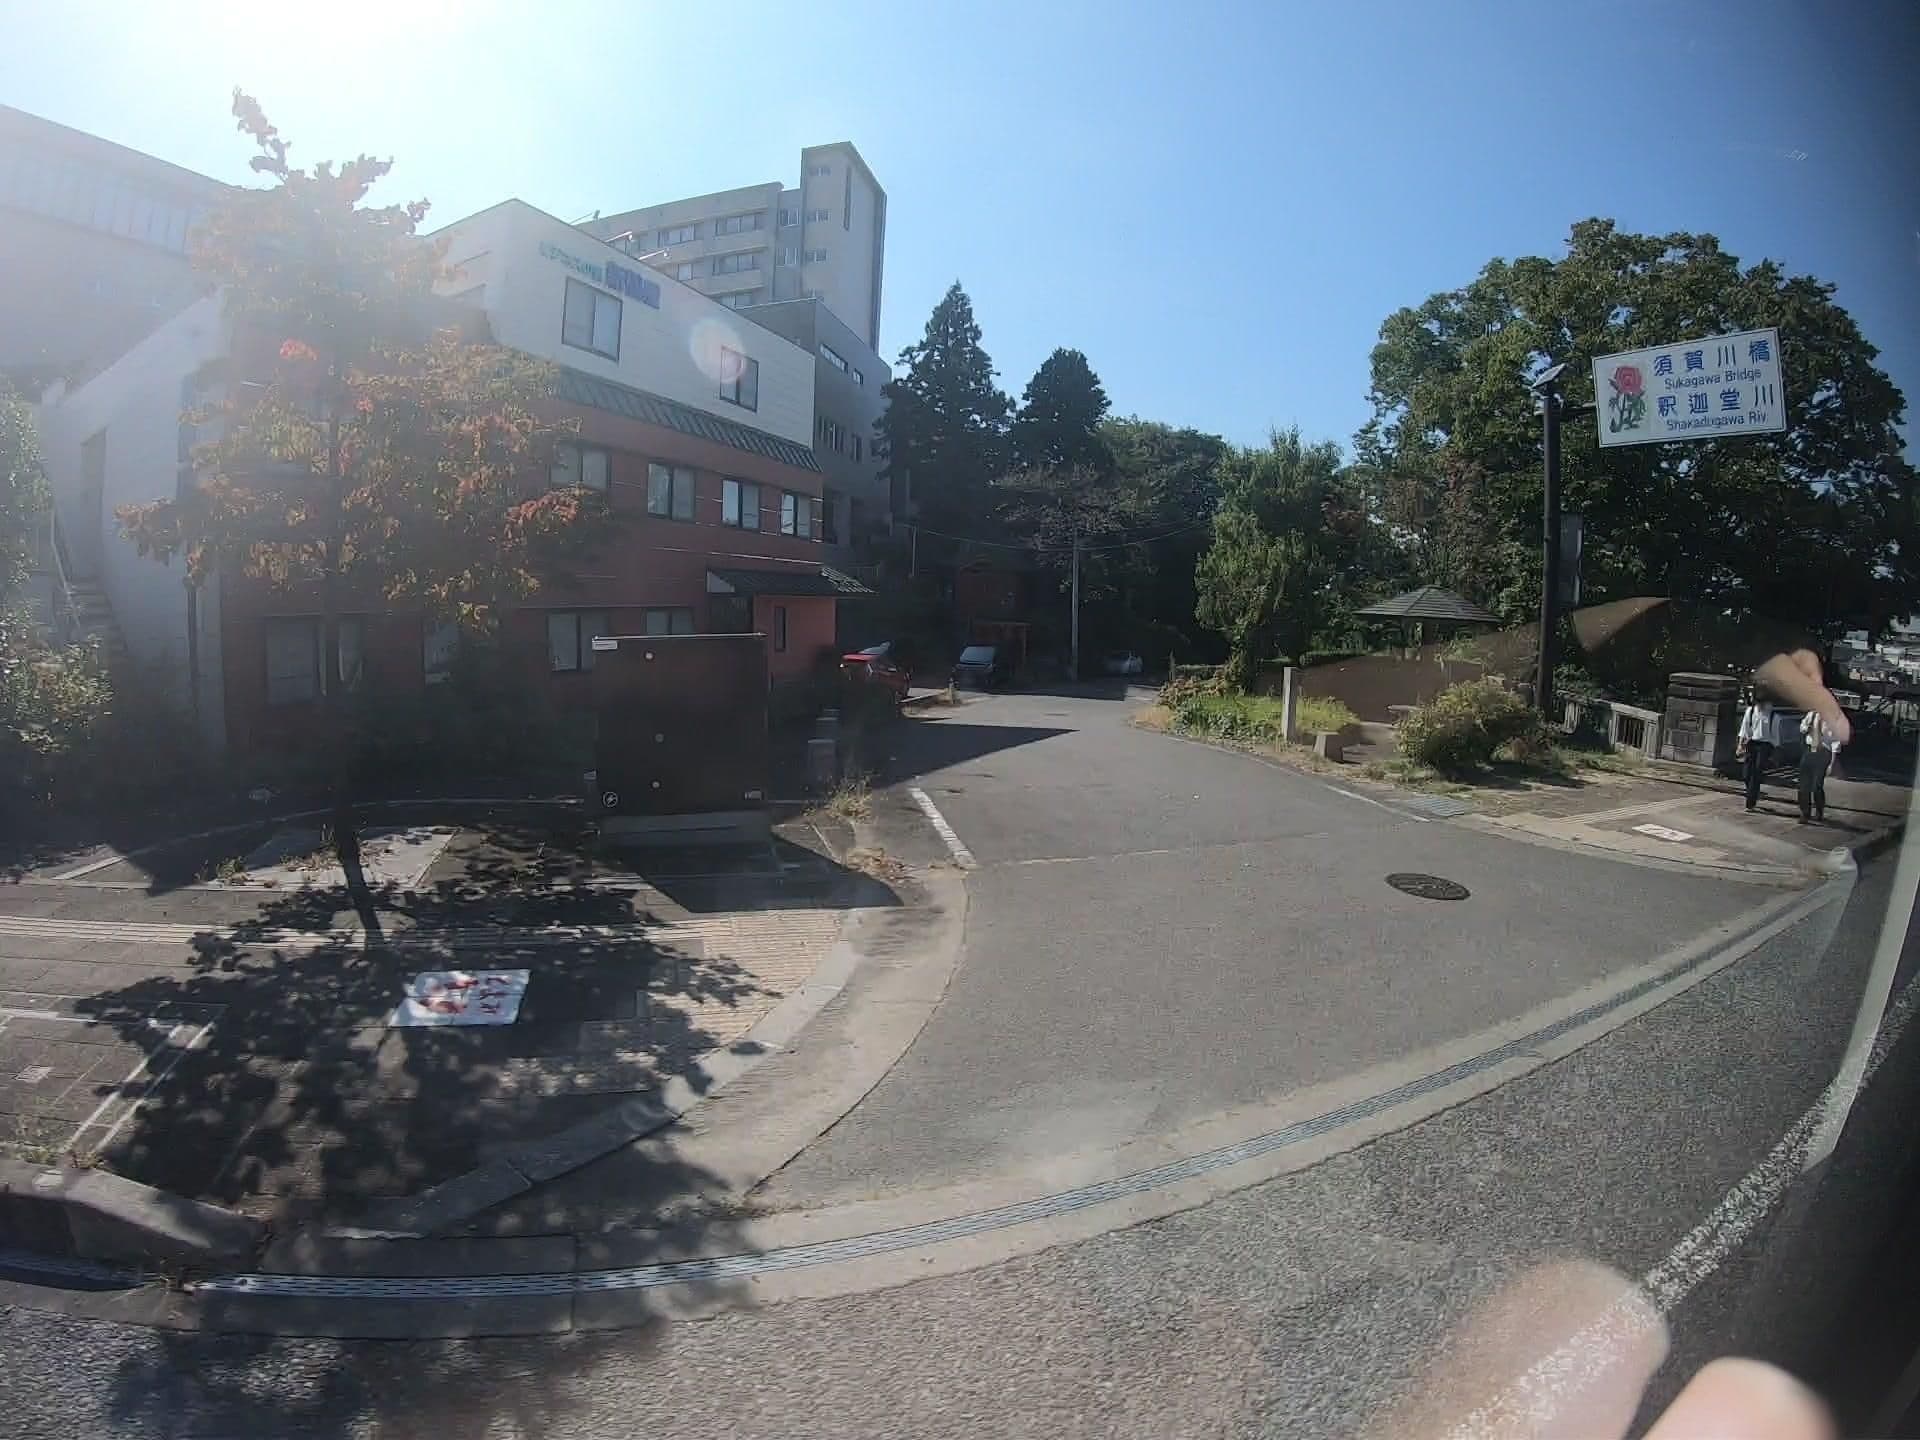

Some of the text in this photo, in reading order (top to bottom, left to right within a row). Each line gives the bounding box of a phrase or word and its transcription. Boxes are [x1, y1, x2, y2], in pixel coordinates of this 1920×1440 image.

[1654, 340, 1770, 376] 須賀川橋
[1665, 368, 1762, 389] Sukagawa Bridge
[1657, 384, 1774, 416] 釈迦堂川
